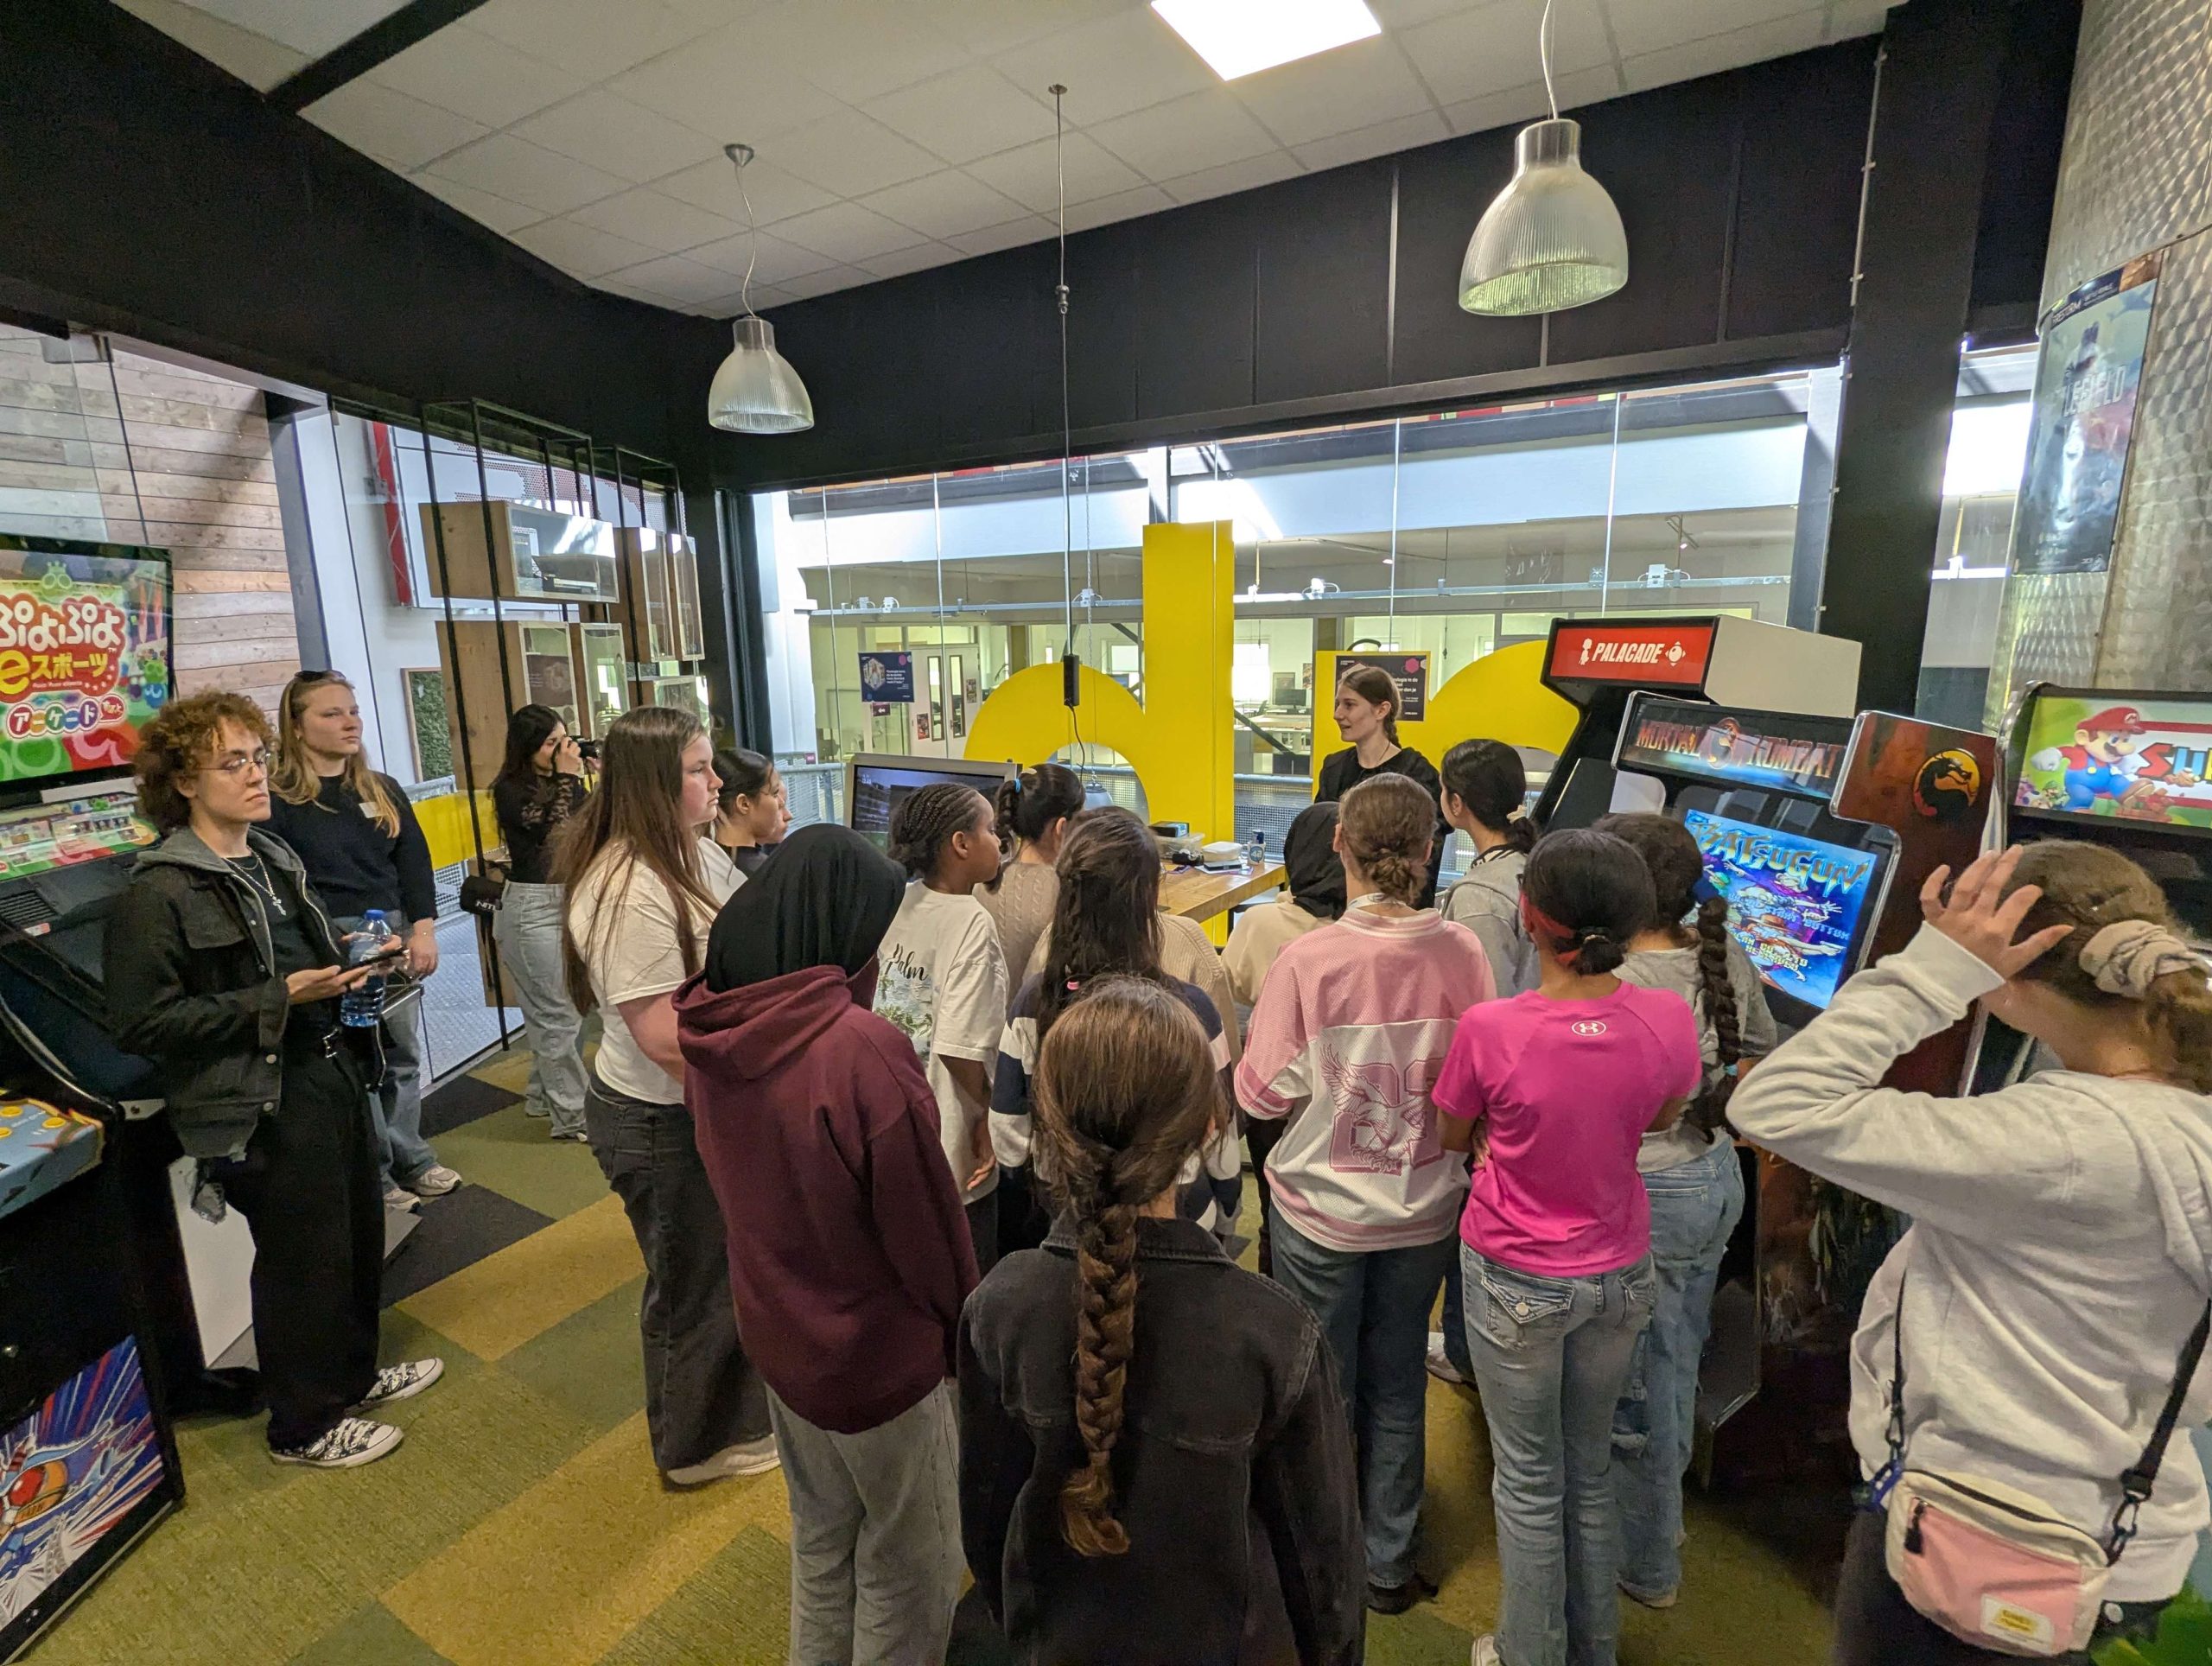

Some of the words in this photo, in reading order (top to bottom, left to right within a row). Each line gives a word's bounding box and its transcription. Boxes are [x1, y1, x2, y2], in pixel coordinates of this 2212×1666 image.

[0, 601, 121, 652] ぷよぷよ
[1592, 643, 1665, 664] PALACADE
[14, 704, 95, 732] アーケード
